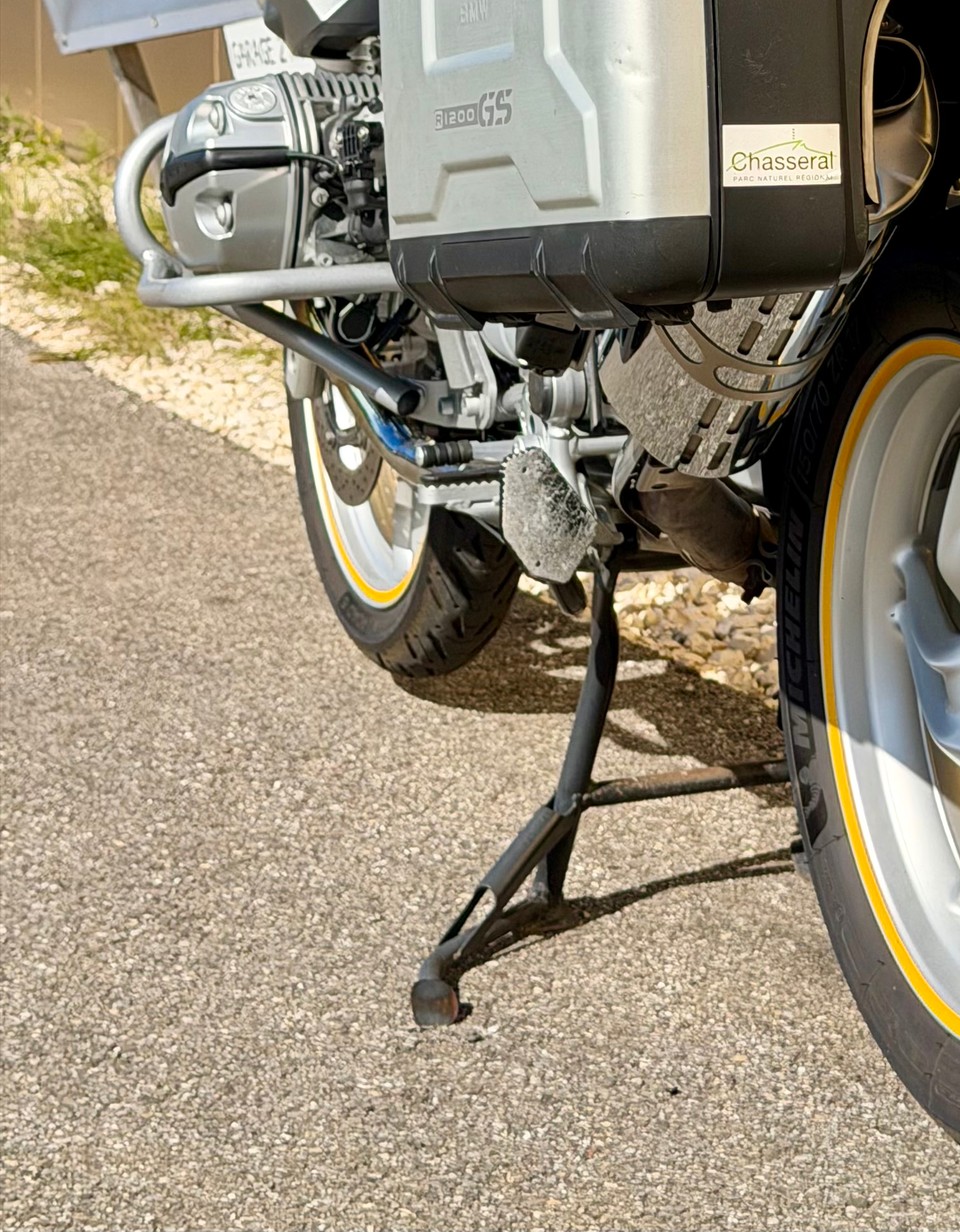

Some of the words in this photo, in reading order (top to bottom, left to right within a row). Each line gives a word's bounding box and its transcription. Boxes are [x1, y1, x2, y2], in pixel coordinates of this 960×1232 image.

[478, 88, 513, 128] GS
[731, 151, 834, 172] Chasseral
[757, 174, 793, 182] NATUREL
[782, 508, 810, 751] MICHELIN
